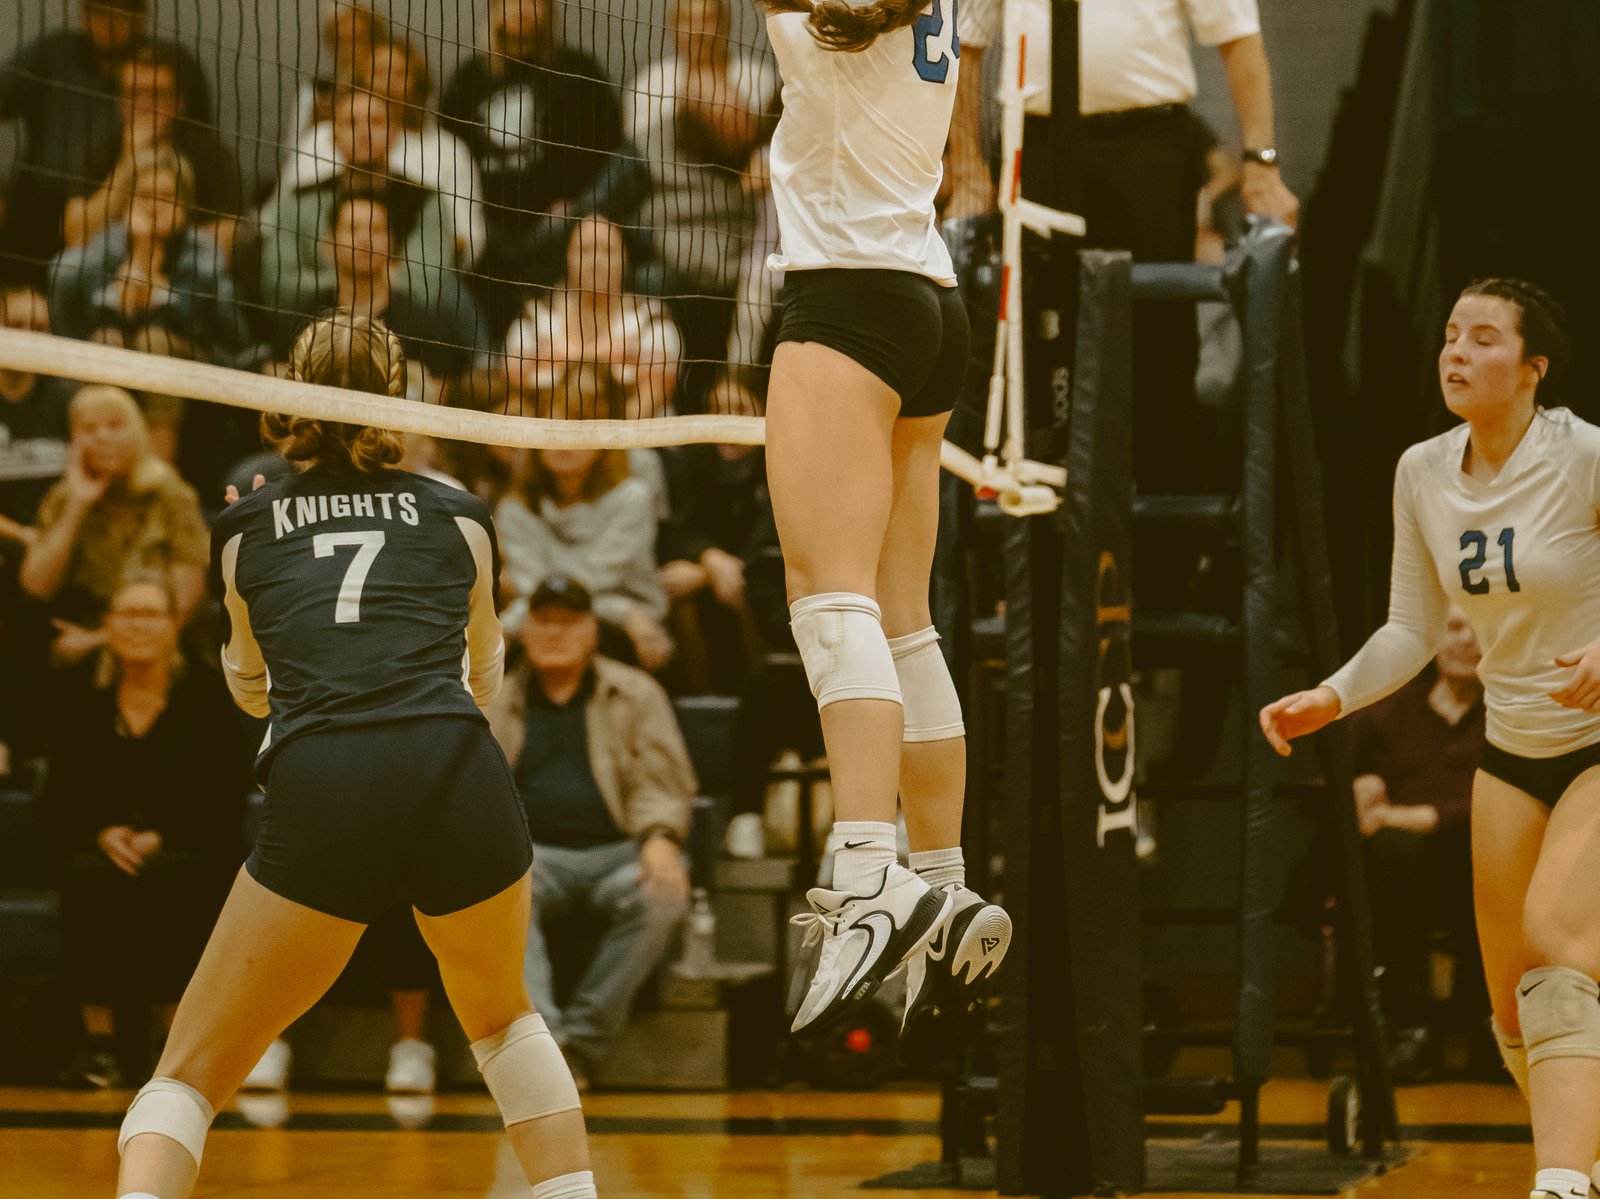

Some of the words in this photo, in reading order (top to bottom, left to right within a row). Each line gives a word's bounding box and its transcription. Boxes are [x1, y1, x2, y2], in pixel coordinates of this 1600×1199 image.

[272, 492, 419, 540] KNIGHTS
[312, 530, 386, 624] 7
[1459, 527, 1520, 594] 21
